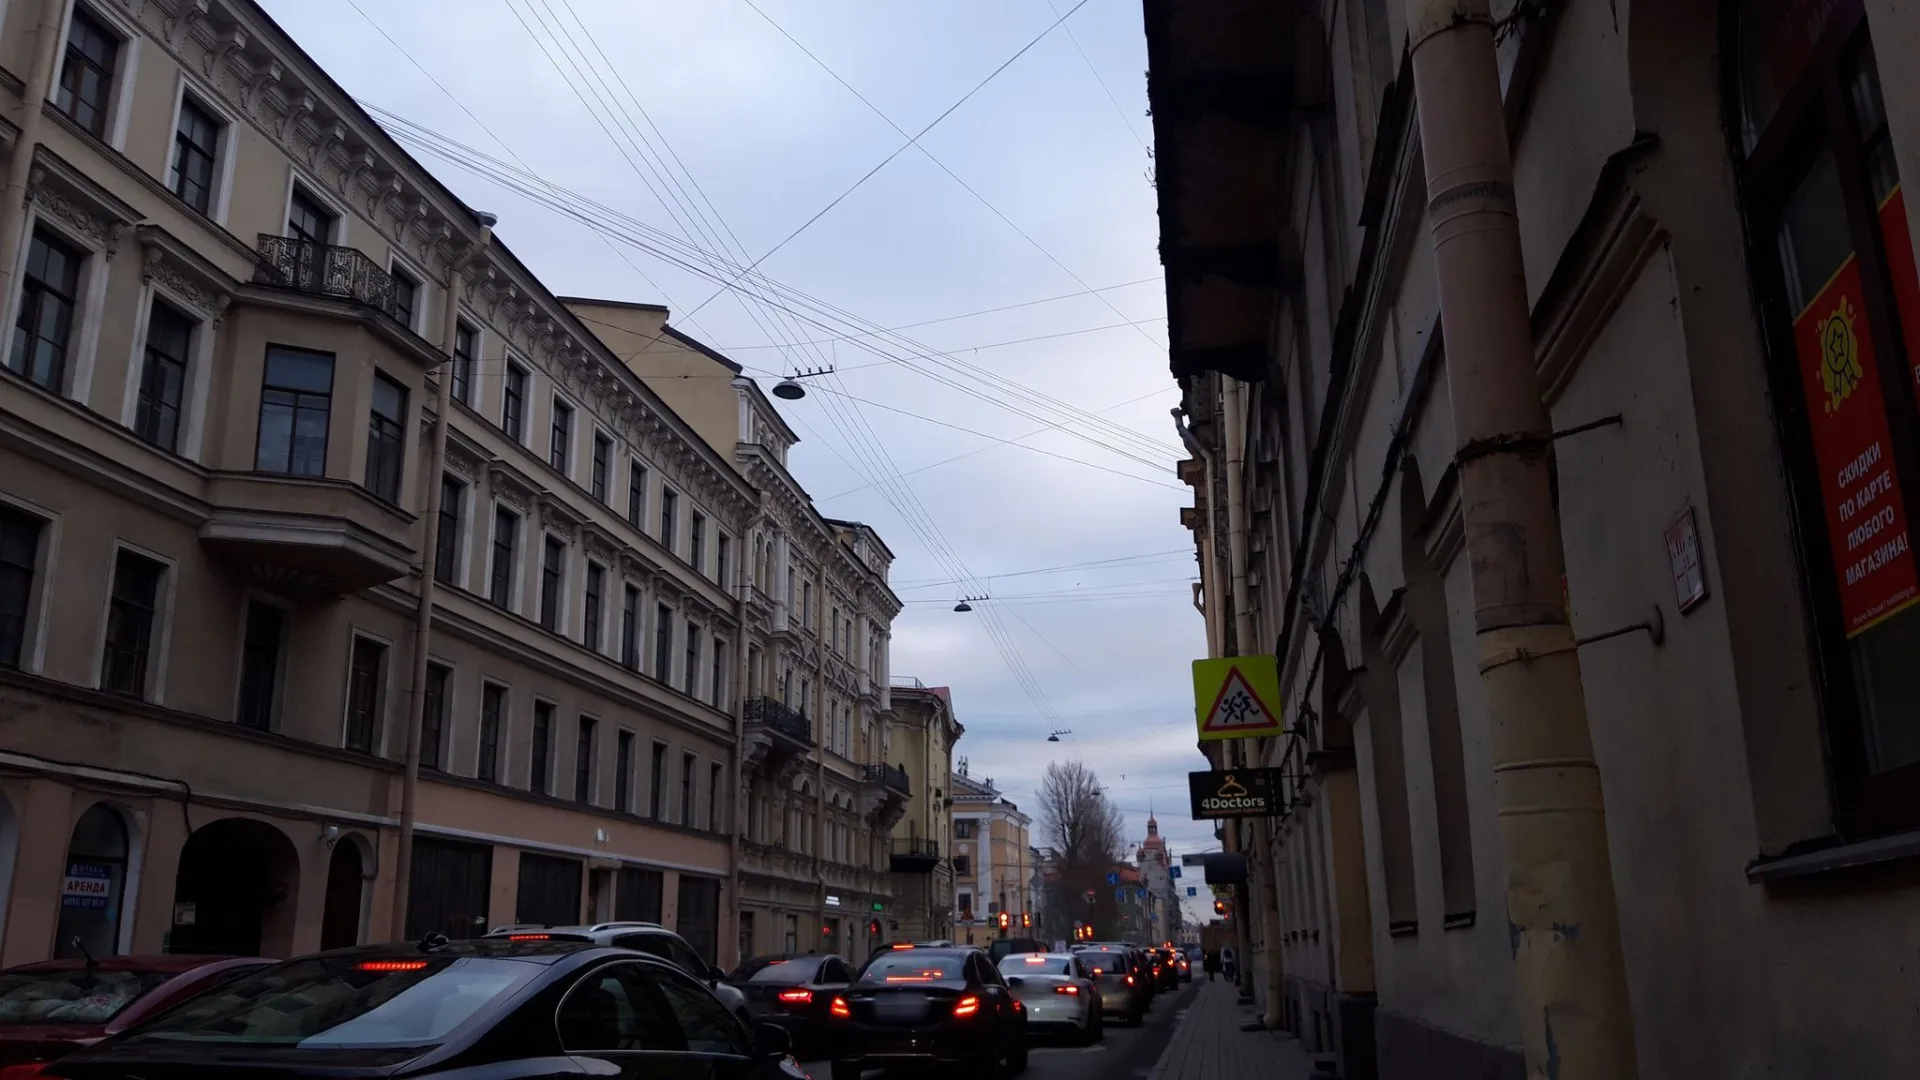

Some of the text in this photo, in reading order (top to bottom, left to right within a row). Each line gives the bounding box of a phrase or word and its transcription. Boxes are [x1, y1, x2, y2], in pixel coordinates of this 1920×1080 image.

[1838, 441, 1881, 488] СКИДКИ
[1839, 470, 1892, 522] ПО КАРТЕ
[1847, 505, 1894, 552] ЛЮБОГО
[1846, 532, 1909, 587] МАГАЗИНА!
[1201, 797, 1265, 809] 4Doctors
[67, 880, 105, 893] АРЕНДА
